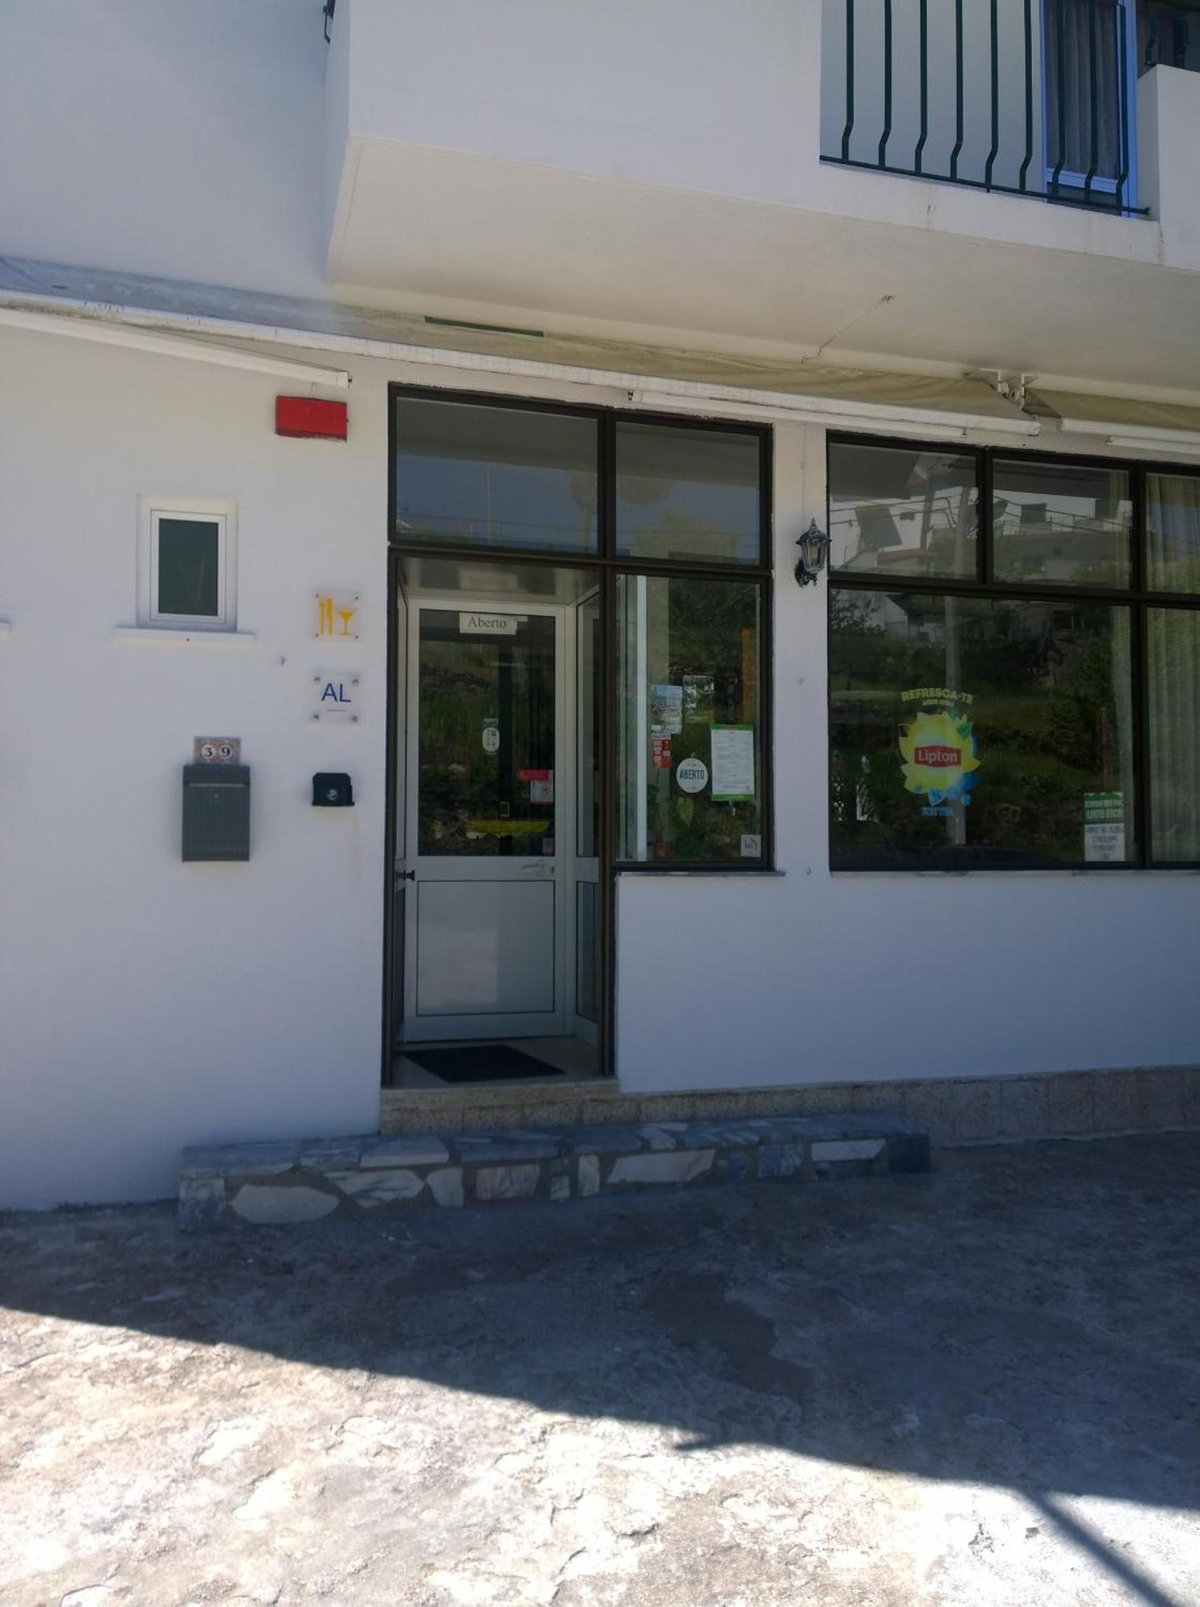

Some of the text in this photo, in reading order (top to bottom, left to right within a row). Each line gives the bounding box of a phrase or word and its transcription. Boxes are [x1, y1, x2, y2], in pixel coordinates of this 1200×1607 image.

[467, 616, 507, 629] Aberto
[321, 682, 351, 703] AL
[900, 687, 975, 705] REFRESCA-TE
[204, 746, 231, 757] 39
[917, 750, 958, 764] Lipton
[679, 769, 705, 781] ABERTO
